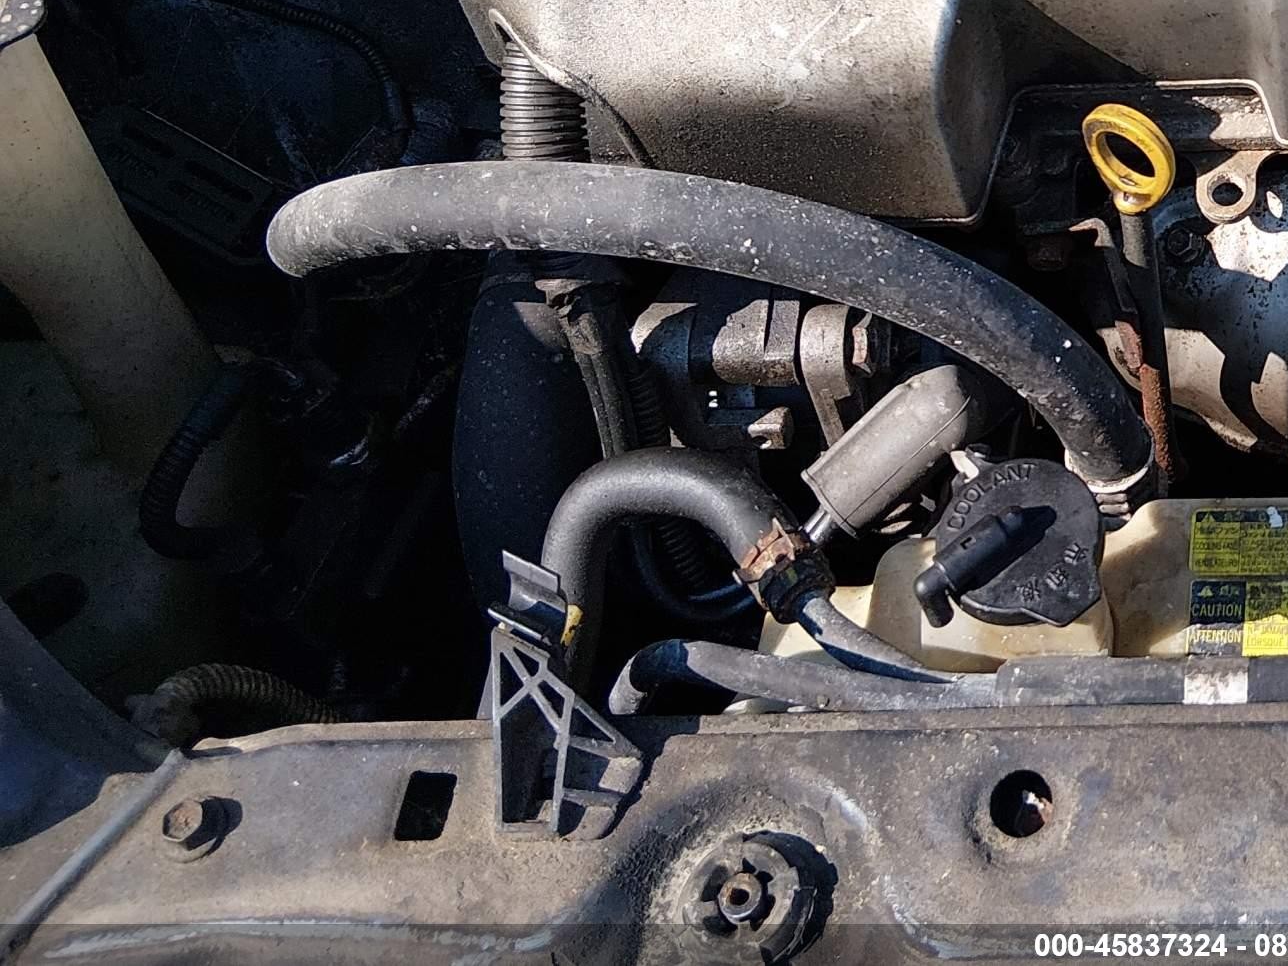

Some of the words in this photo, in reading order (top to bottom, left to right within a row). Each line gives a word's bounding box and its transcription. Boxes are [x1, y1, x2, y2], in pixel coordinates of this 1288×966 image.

[947, 463, 1037, 530] COOLANT
[1191, 602, 1242, 618] CAUTION
[1189, 629, 1242, 644] ATTENTION
